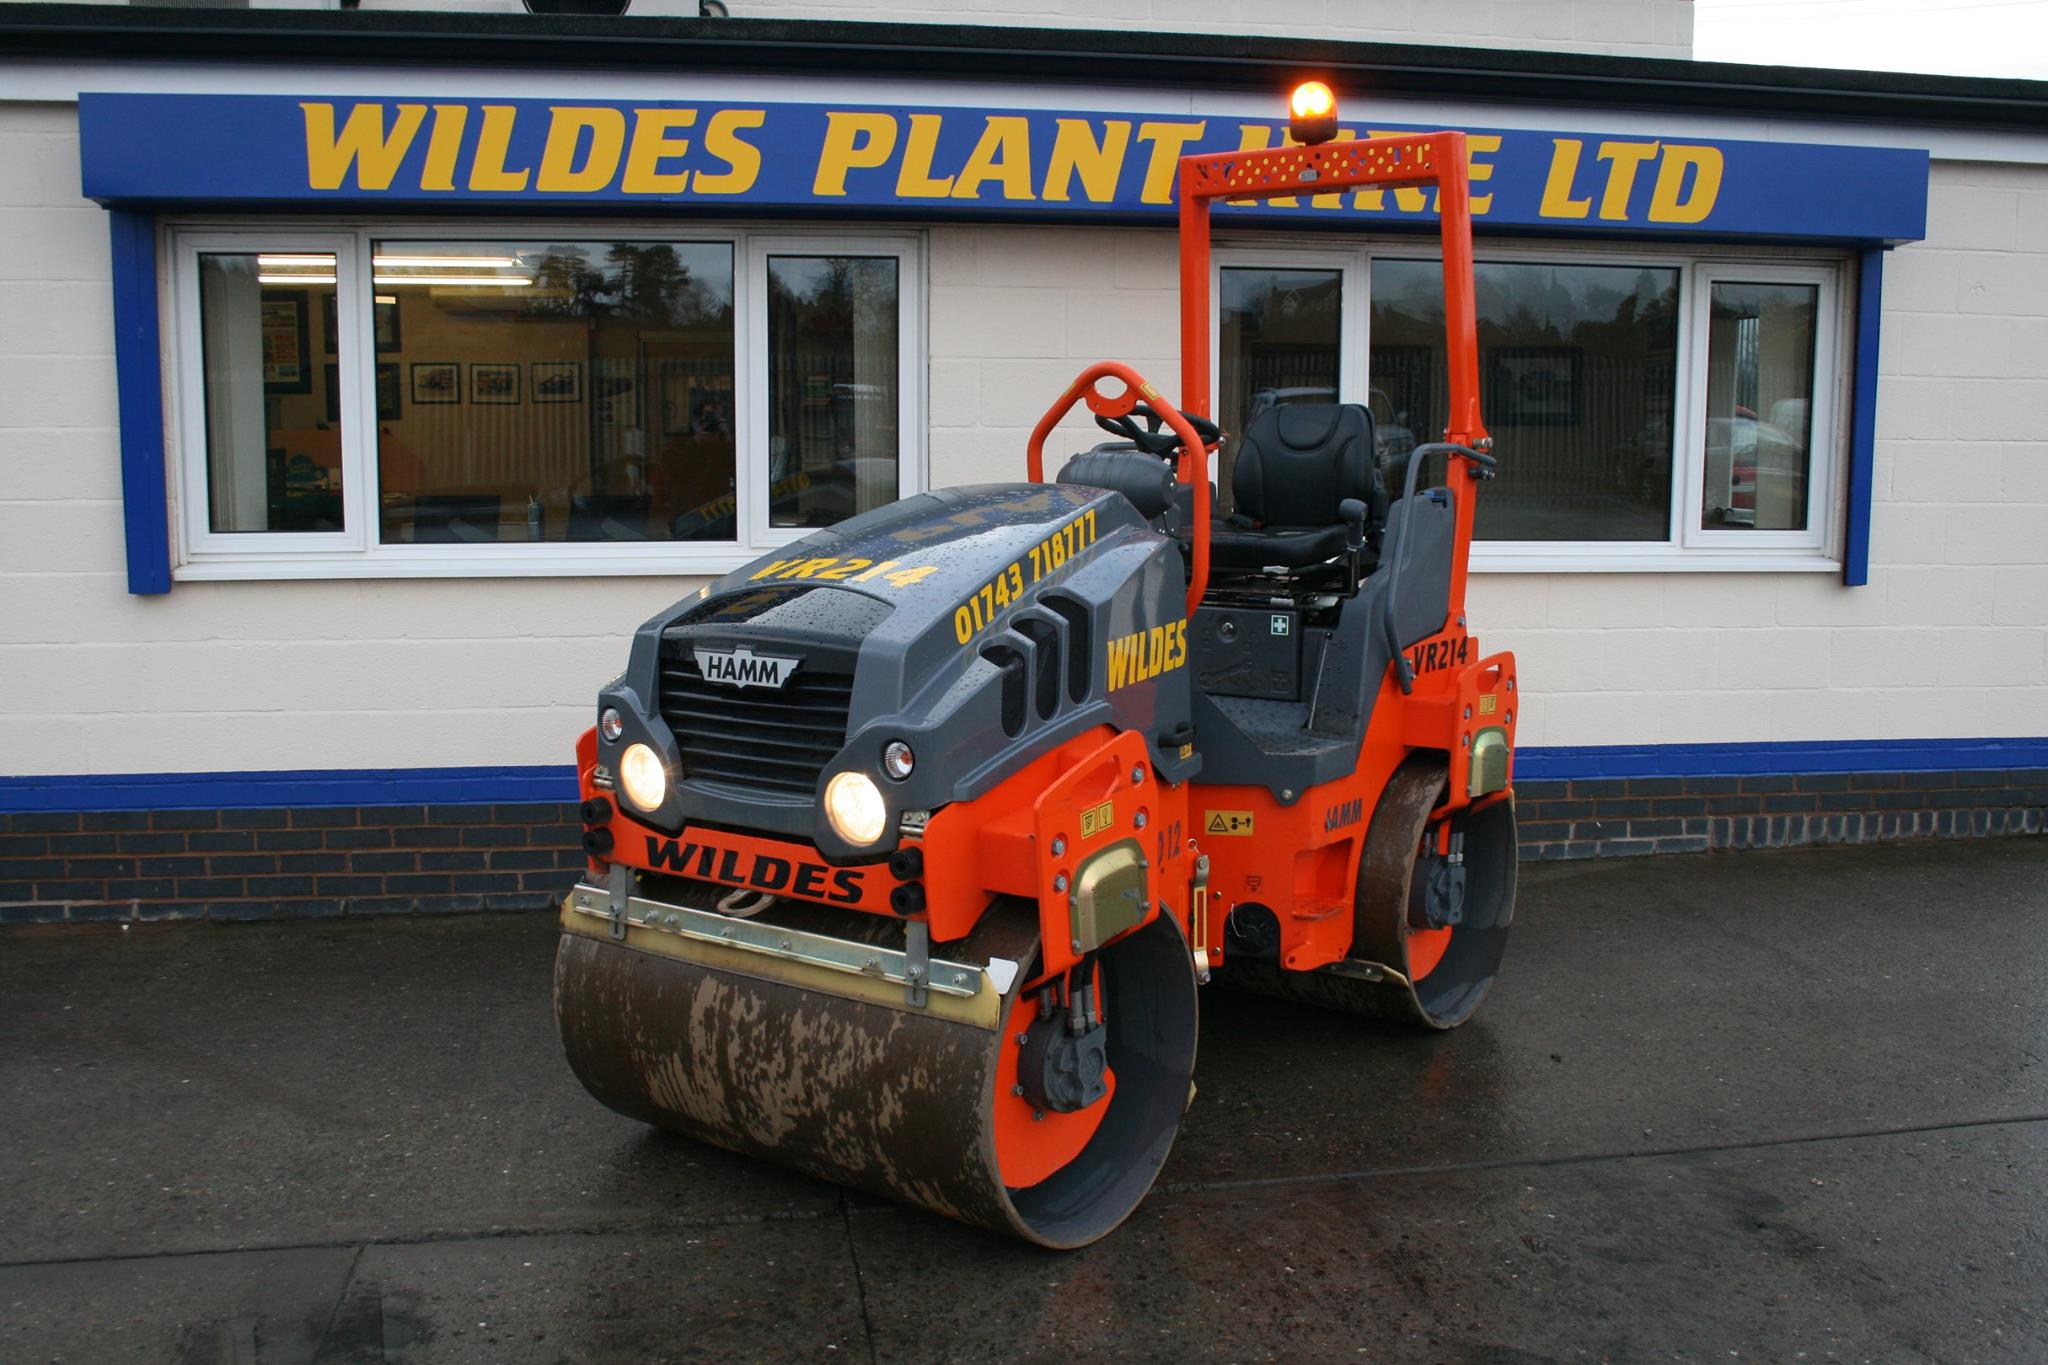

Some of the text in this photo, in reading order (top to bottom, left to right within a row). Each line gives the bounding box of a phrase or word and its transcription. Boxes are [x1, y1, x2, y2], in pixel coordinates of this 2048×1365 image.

[301, 102, 766, 195] WILDES
[813, 112, 1206, 206] PLANT
[1539, 138, 1724, 224] LTD
[750, 557, 939, 588] VR214
[954, 509, 1097, 645] 01743 718777
[707, 655, 779, 685] HAMM
[1107, 618, 1189, 692] WILDES
[1413, 635, 1468, 676] VR214
[645, 835, 865, 904] WILDES
